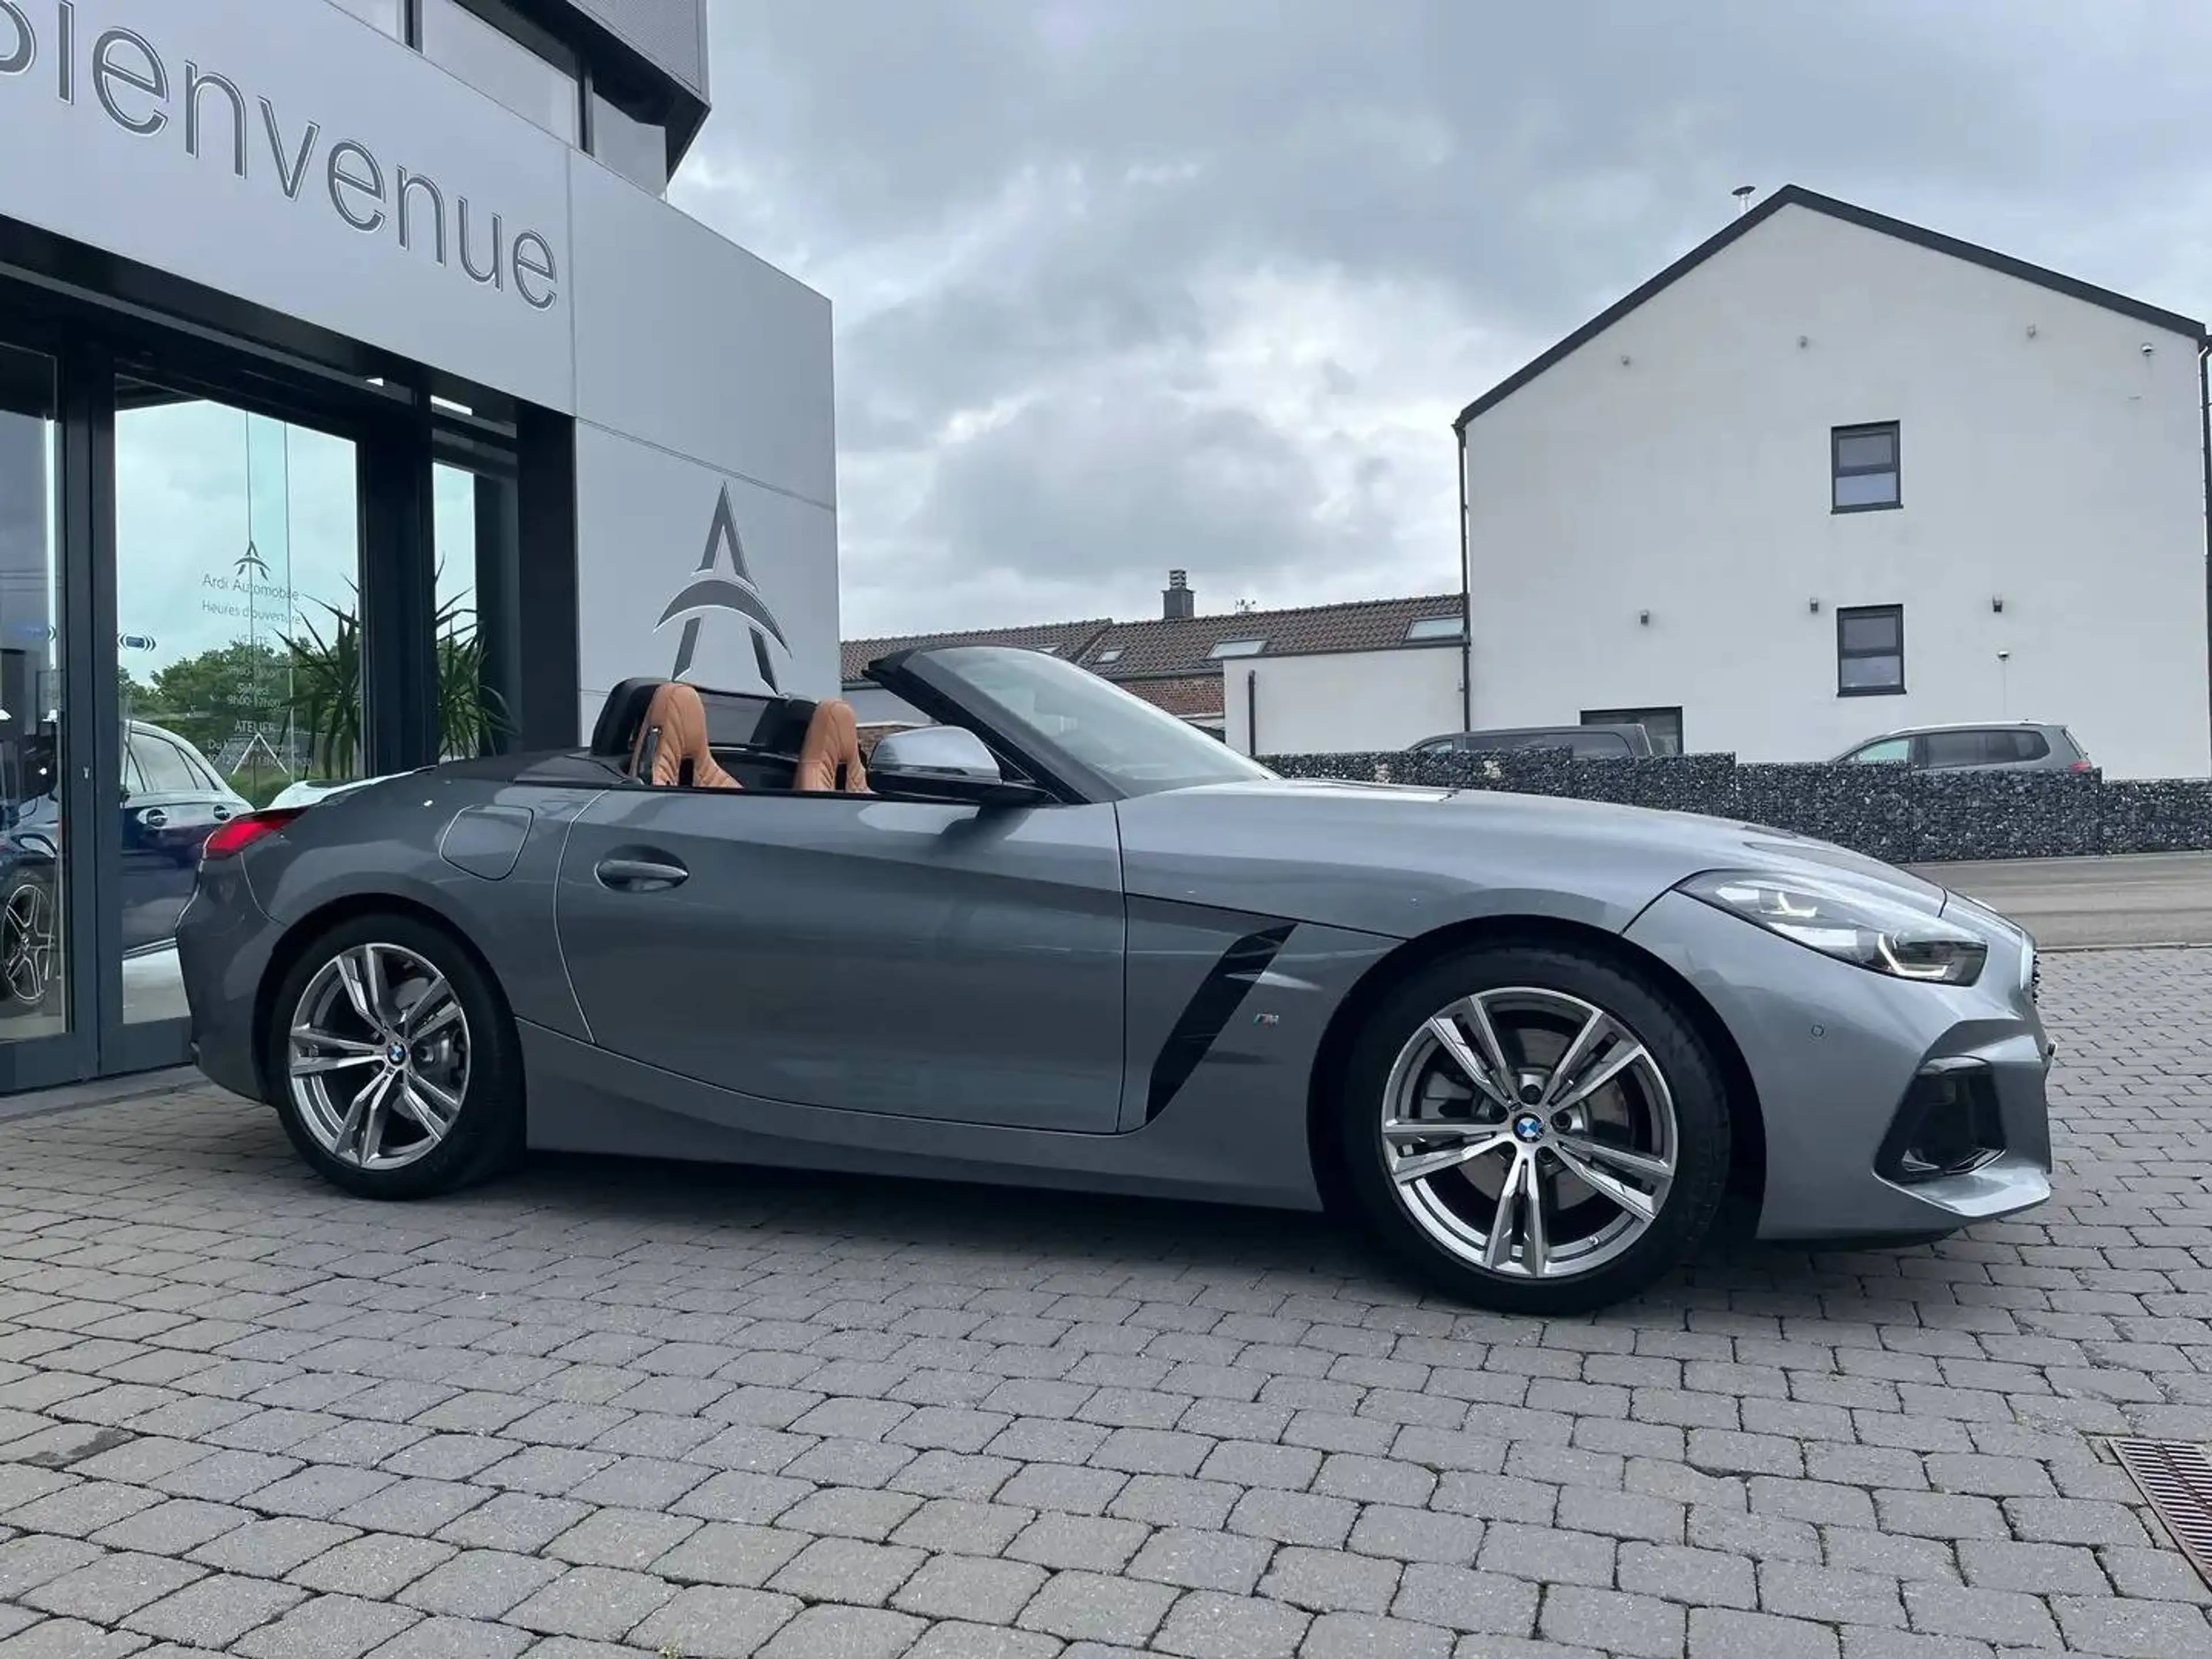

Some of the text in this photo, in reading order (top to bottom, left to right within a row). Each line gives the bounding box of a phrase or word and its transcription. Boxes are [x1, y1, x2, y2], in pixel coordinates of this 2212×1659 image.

[0, 0, 558, 312] ienvenue
[202, 574, 229, 589] Ardi
[234, 720, 274, 734] ATELIER
